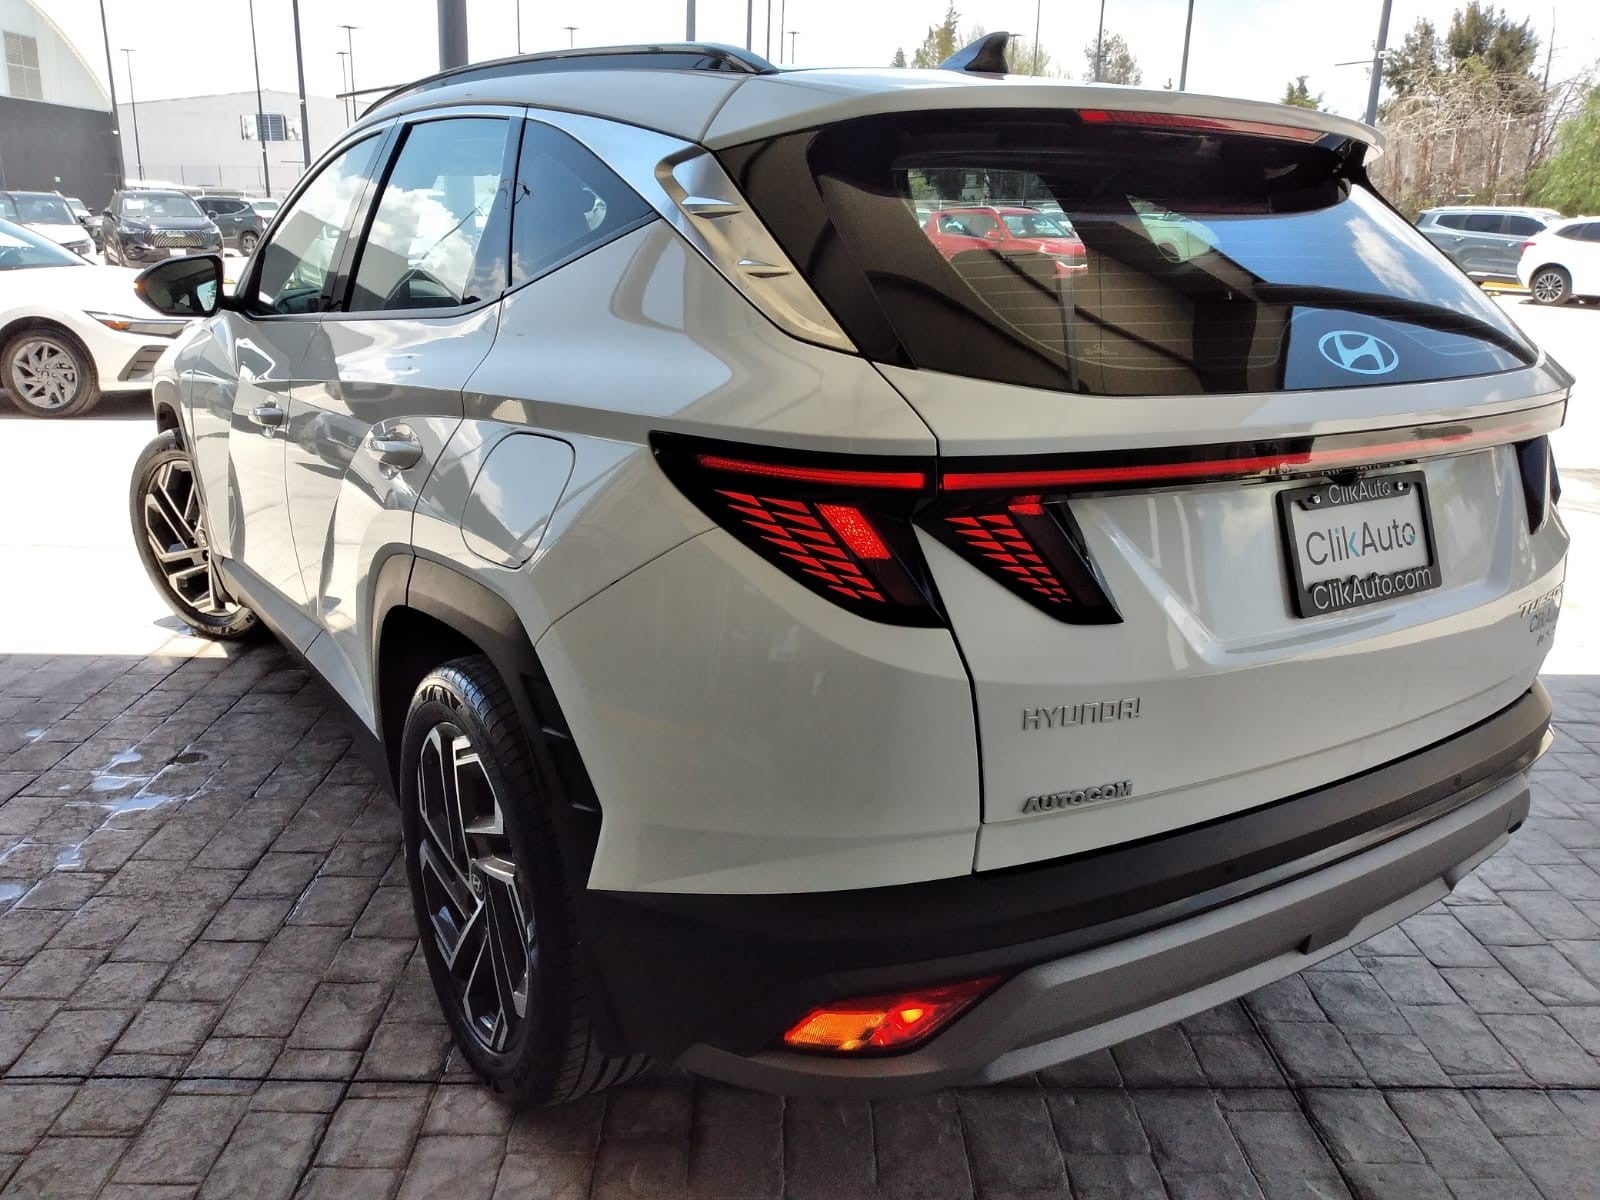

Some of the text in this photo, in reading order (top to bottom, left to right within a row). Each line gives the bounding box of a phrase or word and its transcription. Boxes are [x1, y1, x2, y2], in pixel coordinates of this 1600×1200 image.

[1328, 479, 1391, 504] ClikAuto
[1305, 518, 1416, 566] ClikAuto
[1313, 568, 1432, 610] ClikAuto.com
[1022, 697, 1143, 730] HYUNDAI
[1022, 780, 1133, 814] AUTOCOM
